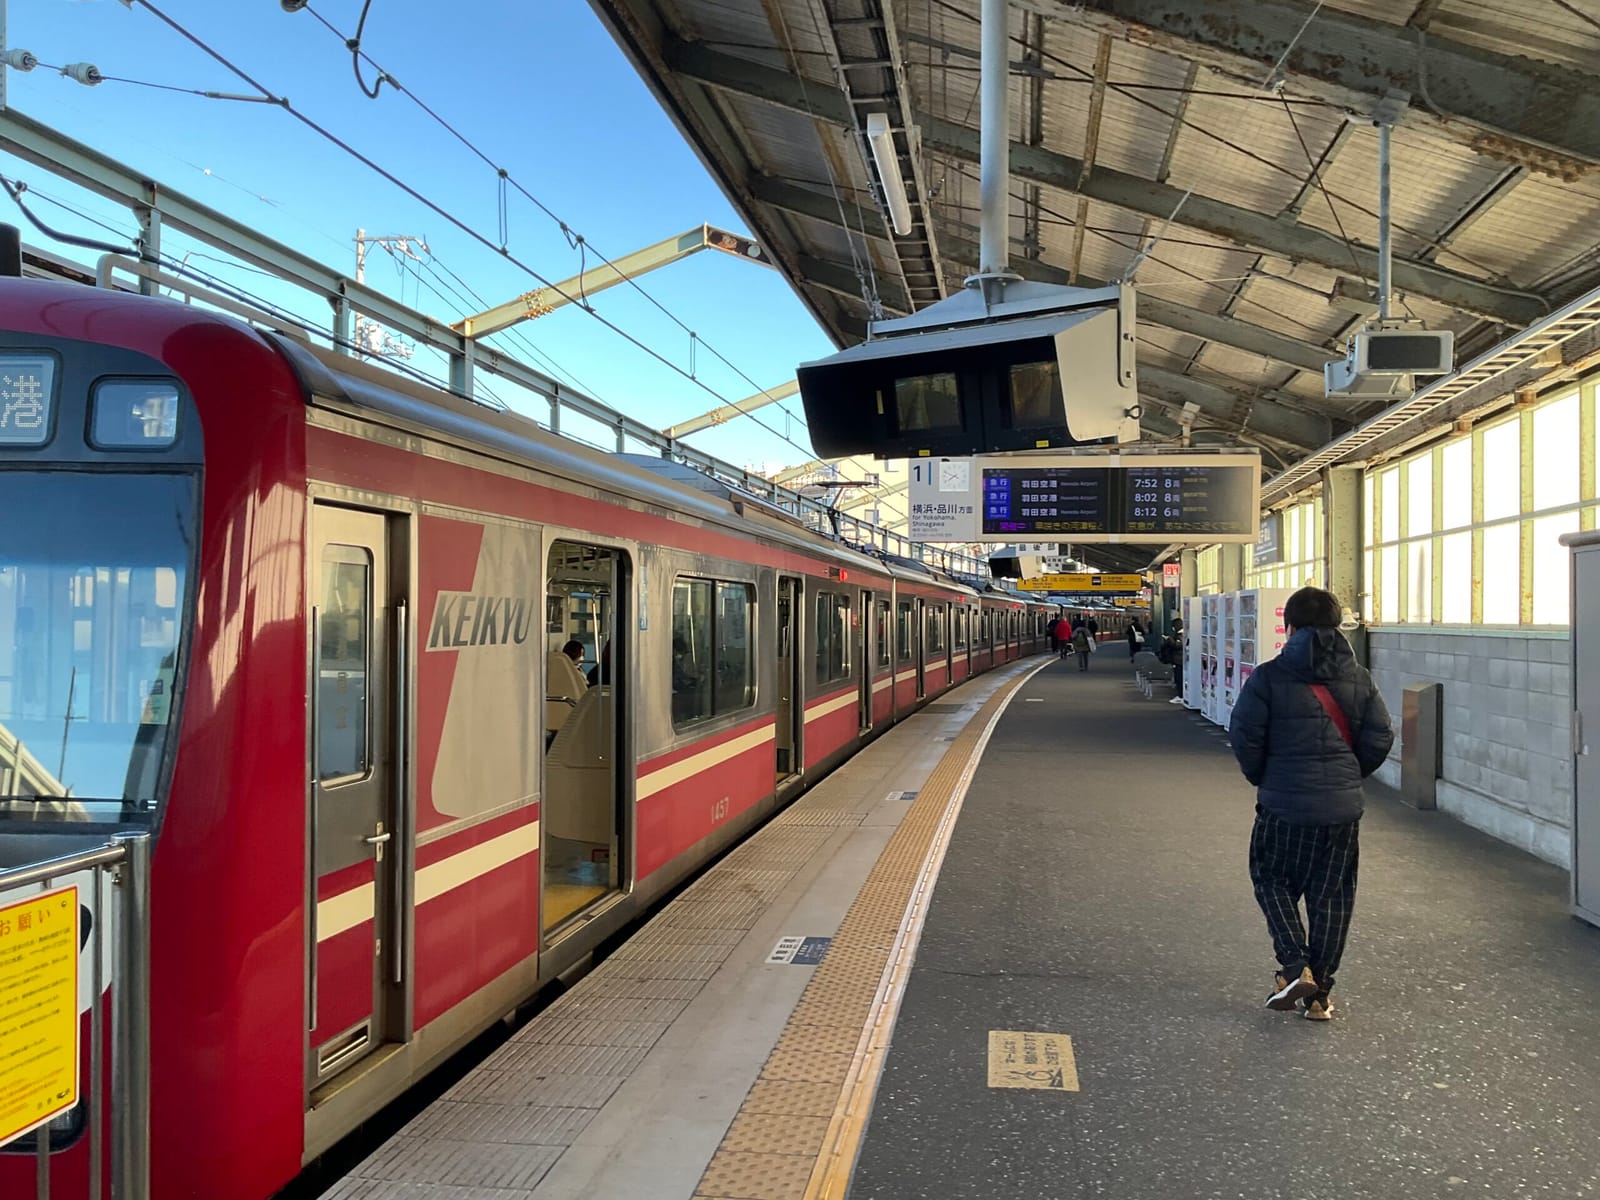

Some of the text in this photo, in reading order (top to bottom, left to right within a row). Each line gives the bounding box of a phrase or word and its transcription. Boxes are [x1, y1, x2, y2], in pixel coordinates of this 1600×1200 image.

[913, 465, 921, 482] 1
[1135, 479, 1157, 488] 7:52
[1134, 493, 1157, 502] 8:02
[1134, 507, 1157, 516] 8:12
[429, 595, 534, 648] KEIKYU
